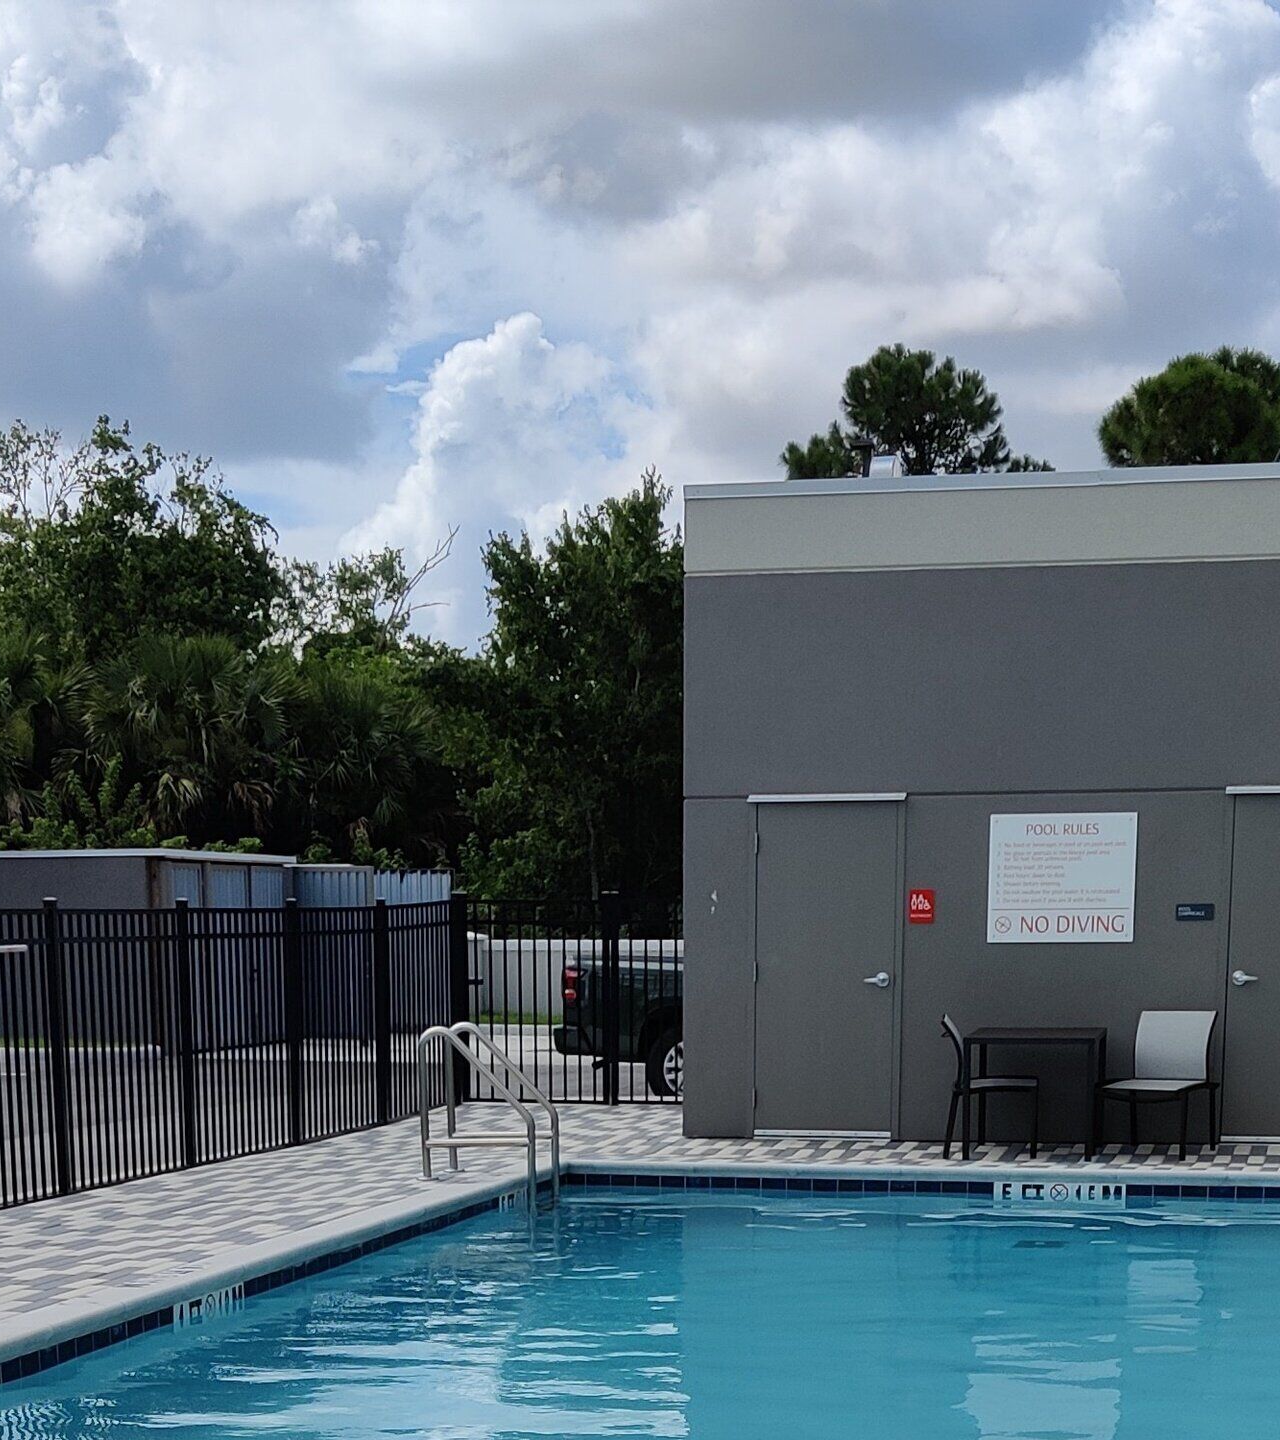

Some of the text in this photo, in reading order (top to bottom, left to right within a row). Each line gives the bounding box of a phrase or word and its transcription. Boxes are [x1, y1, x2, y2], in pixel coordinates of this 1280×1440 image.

[1025, 822, 1100, 836] POOL RULES
[1020, 914, 1125, 933] NO DIVING
